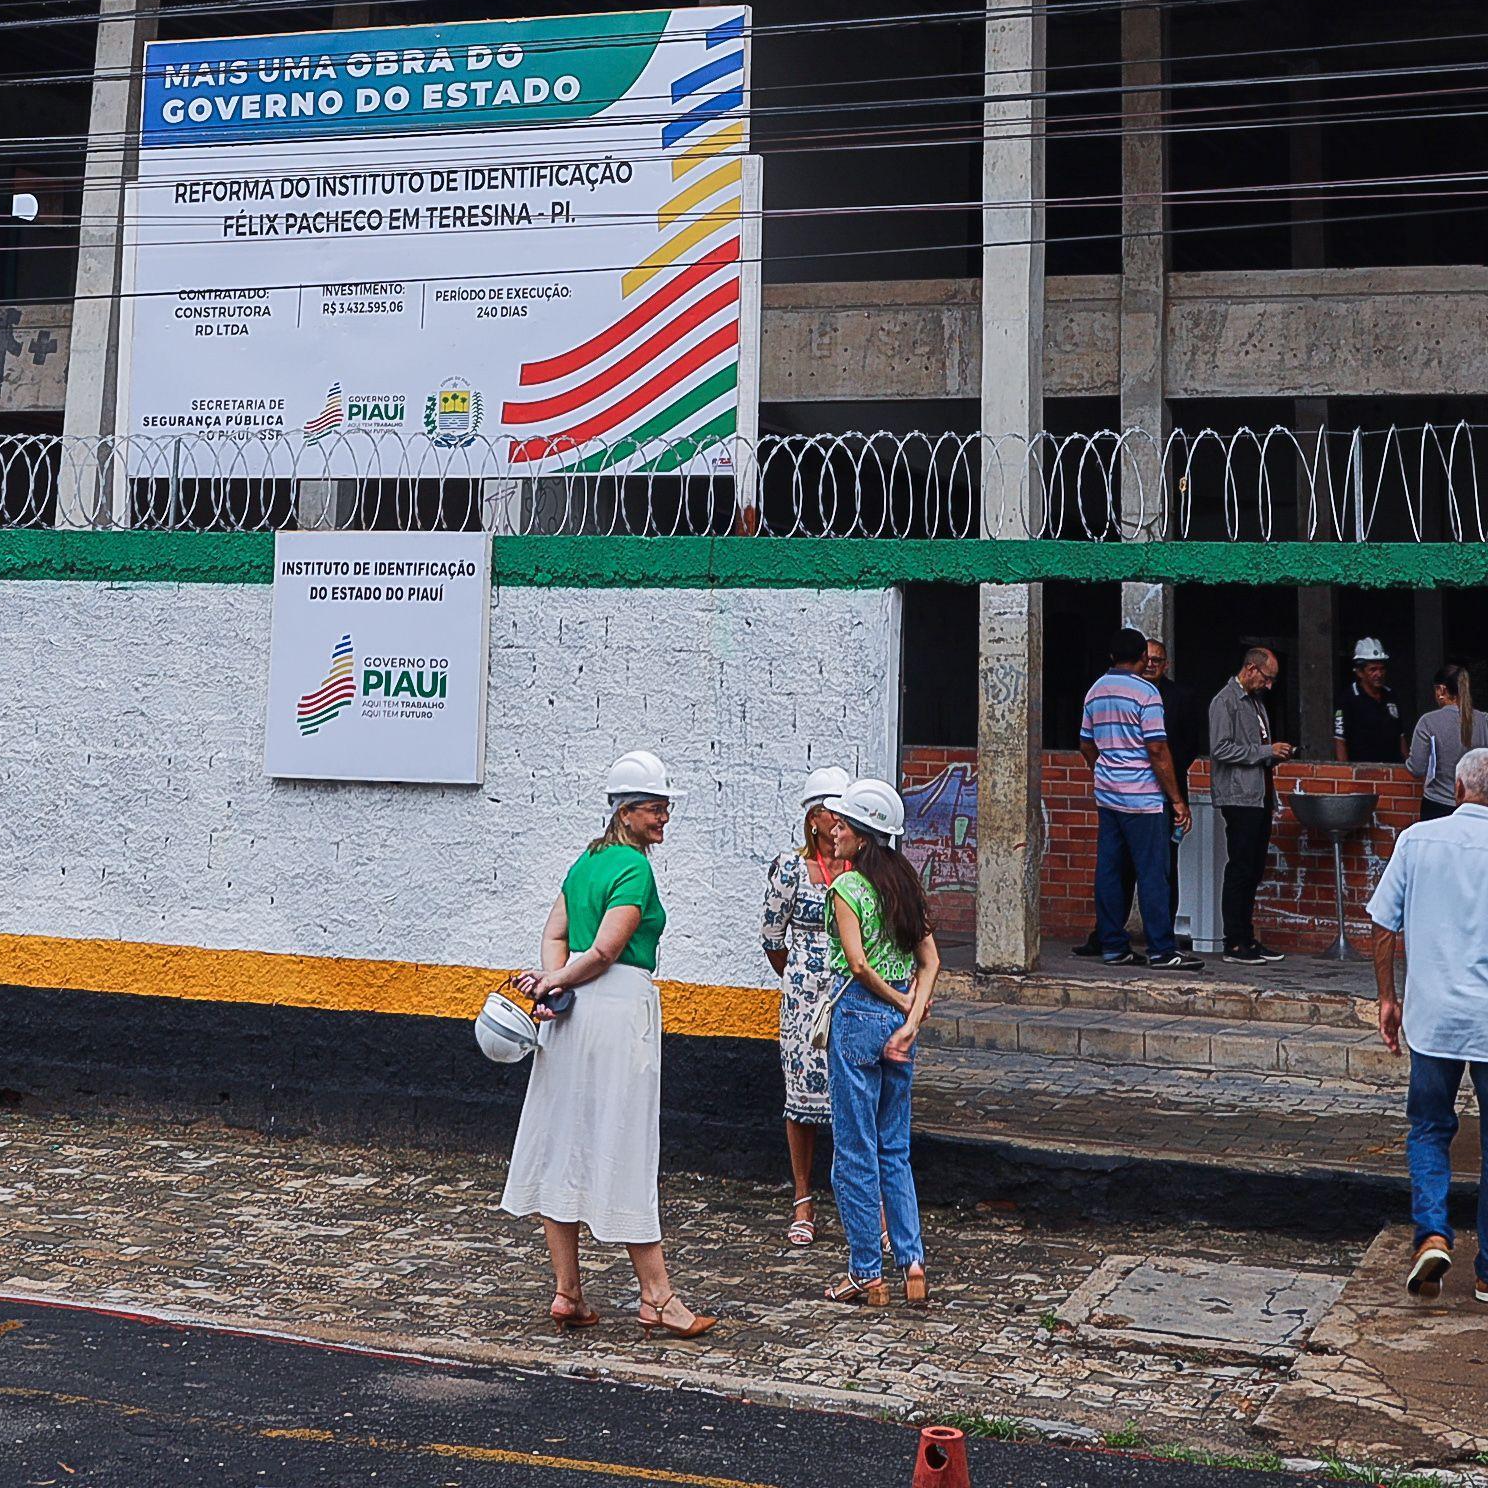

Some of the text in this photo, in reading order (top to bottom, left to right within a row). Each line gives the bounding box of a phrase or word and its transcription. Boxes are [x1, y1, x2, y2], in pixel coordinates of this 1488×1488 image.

[163, 42, 525, 90] MAIS UMA OBRA DO
[161, 74, 582, 125] GOVERNO DO ESTADO
[174, 155, 634, 205] REFORMA DO INSTITUTO DE IDENTIFICAÇÃO
[222, 202, 280, 238] FÉLIX
[284, 208, 384, 235] PACHECO
[387, 207, 421, 231] EM
[425, 202, 533, 229] TERESINA
[550, 200, 576, 224] PI.
[178, 283, 573, 302] CONTRATADO: INVESTIMENTO: PERÍODO DE EXECUÇÃO:
[174, 301, 528, 319] CONSTRUTORA R$ 3.432.595,06 240 DIAS
[194, 323, 249, 337] RD LTDA
[191, 399, 285, 411] SECRETARIA DE
[348, 395, 390, 403] GOVERNO
[142, 412, 284, 429] SEGURANÇA PÚBLICA
[347, 402, 405, 421] PIAUÍ
[281, 559, 476, 580] INSTITUTO DE IDENTIFICAÇÃO
[309, 584, 444, 602] DO ESTADO DO PIAUÍ
[364, 657, 449, 669] GOVERNO DO
[362, 670, 447, 699] PIAUÍ
[362, 700, 382, 709] AQUI
[383, 700, 399, 708] TEM
[361, 710, 382, 718] AQUI
[383, 710, 399, 718] TEM
